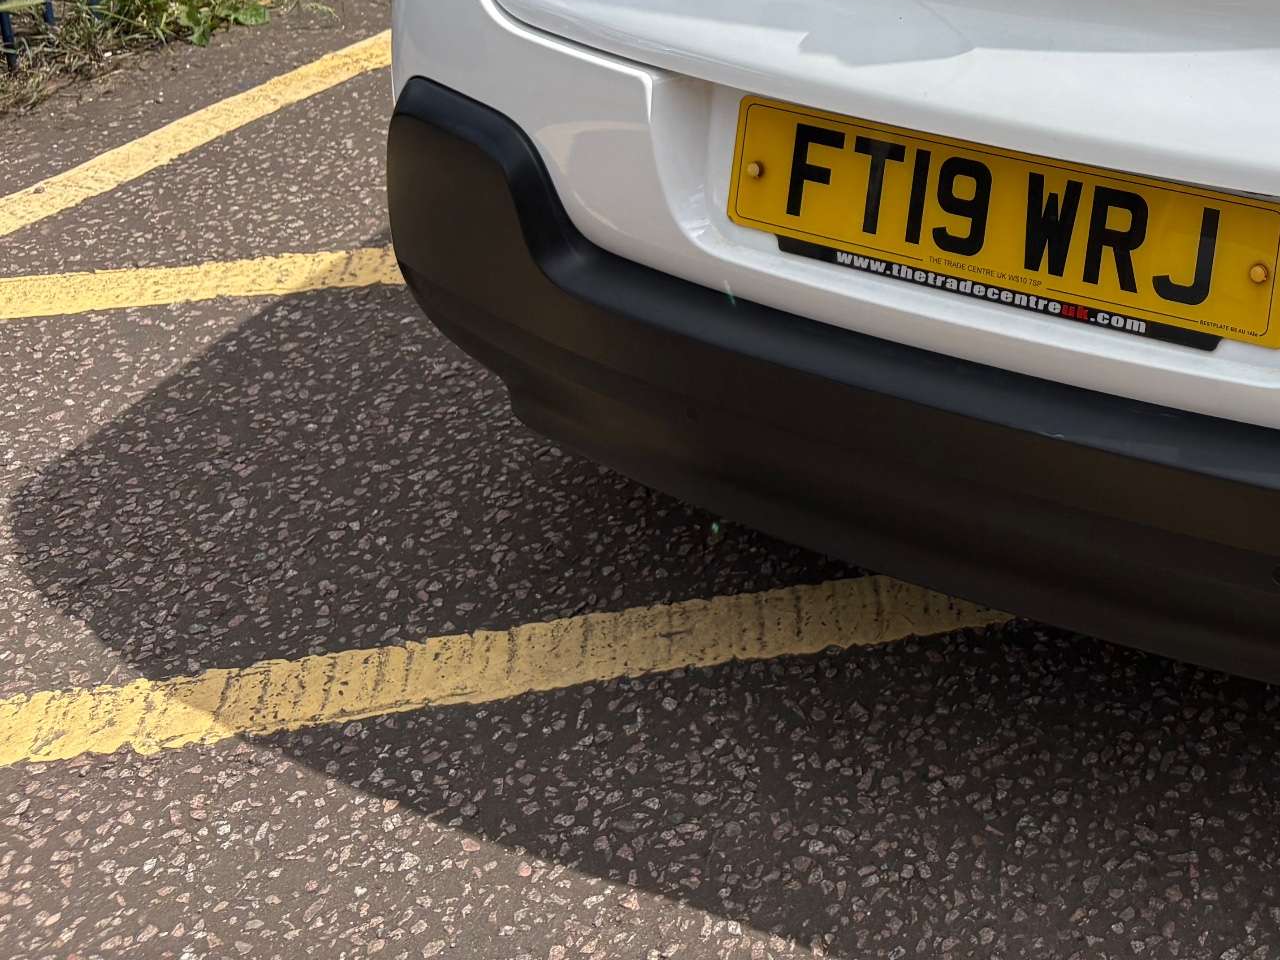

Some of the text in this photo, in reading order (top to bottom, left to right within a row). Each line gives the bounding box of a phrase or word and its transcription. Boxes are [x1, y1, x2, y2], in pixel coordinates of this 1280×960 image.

[785, 122, 1221, 306] FT19 WRJ
[836, 251, 1147, 334] www.thetradecentreuk.com
[929, 255, 942, 265] THE
[944, 259, 966, 271] TRADE
[967, 264, 995, 278] CENTRE
